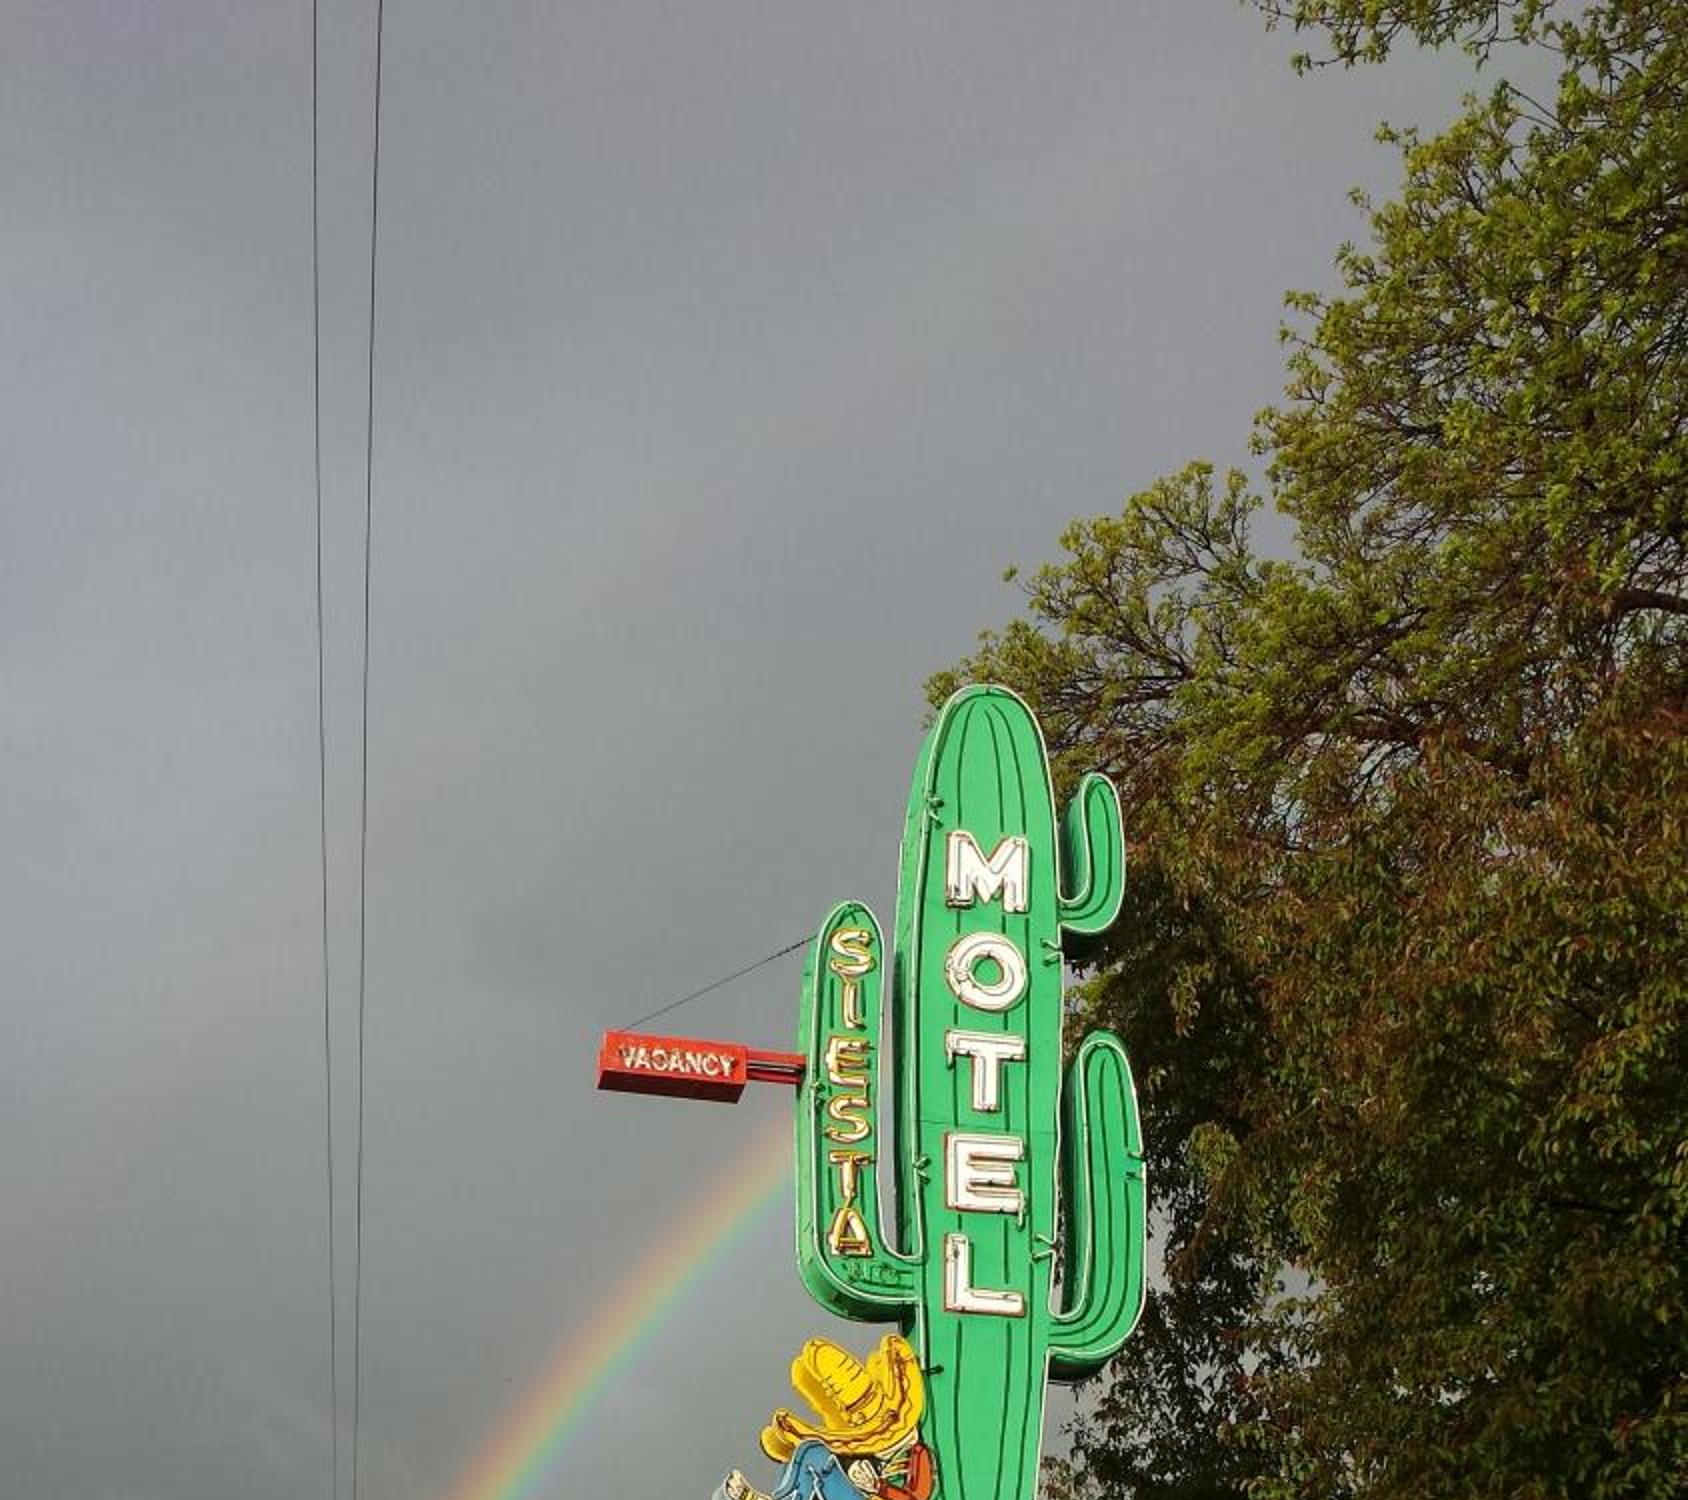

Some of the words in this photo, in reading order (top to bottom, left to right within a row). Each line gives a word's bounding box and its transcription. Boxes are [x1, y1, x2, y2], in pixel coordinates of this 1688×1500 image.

[617, 1044, 738, 1077] VACANCY
[827, 926, 876, 1258] SIESTA
[944, 829, 1030, 1318] MOTEL
